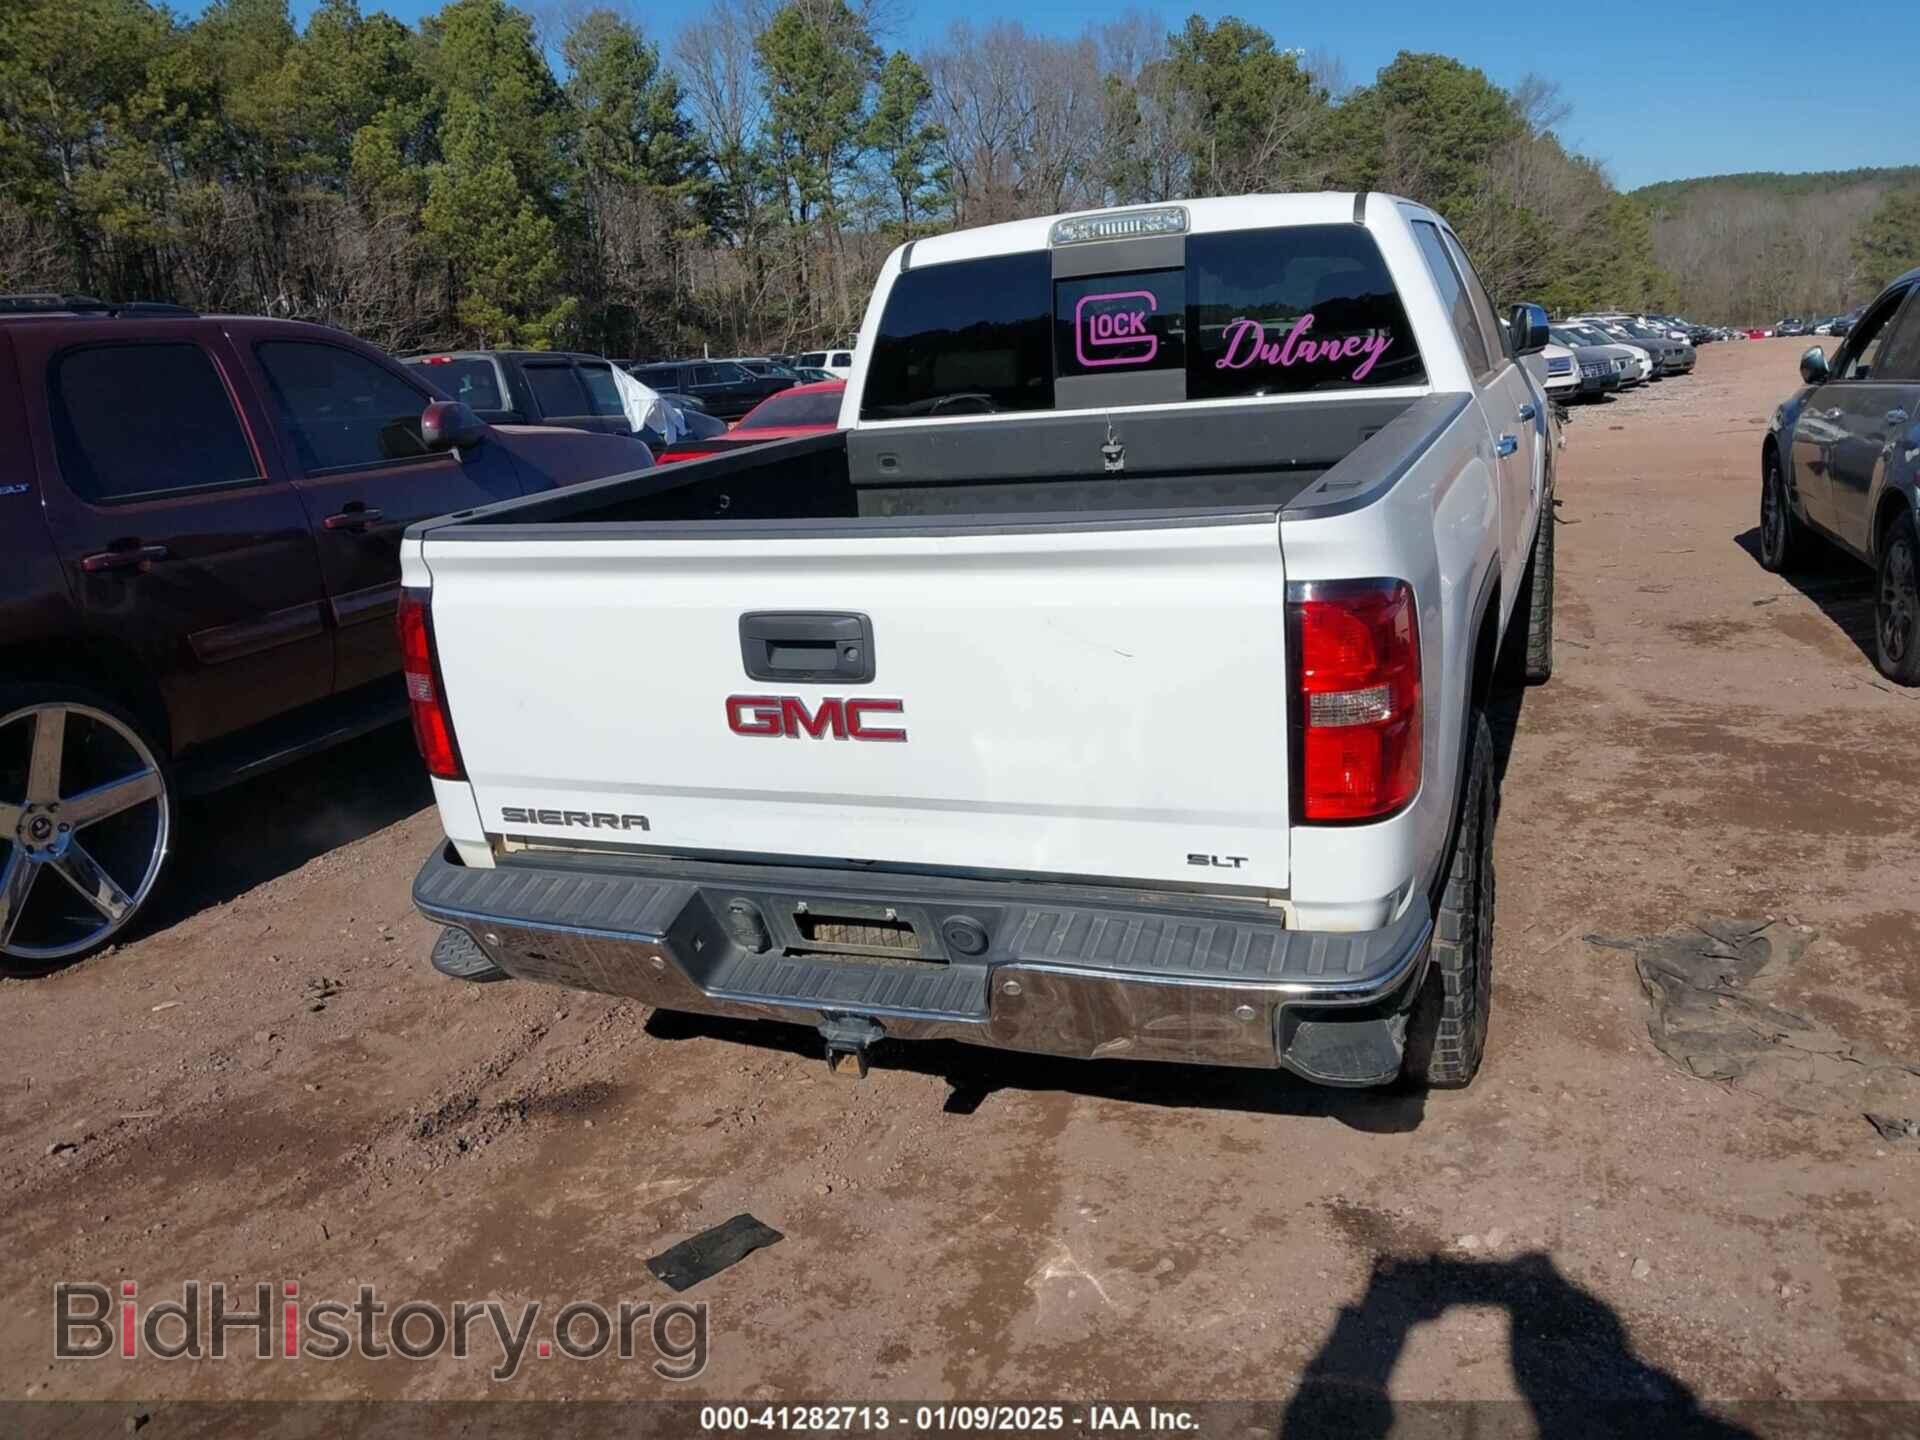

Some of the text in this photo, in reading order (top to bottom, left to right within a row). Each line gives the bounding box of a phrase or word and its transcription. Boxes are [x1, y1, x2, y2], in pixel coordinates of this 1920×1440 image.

[1214, 313, 1393, 381] Dulaney
[726, 694, 908, 743] GMC
[502, 806, 652, 832] SIERRA
[1186, 853, 1250, 869] SLT
